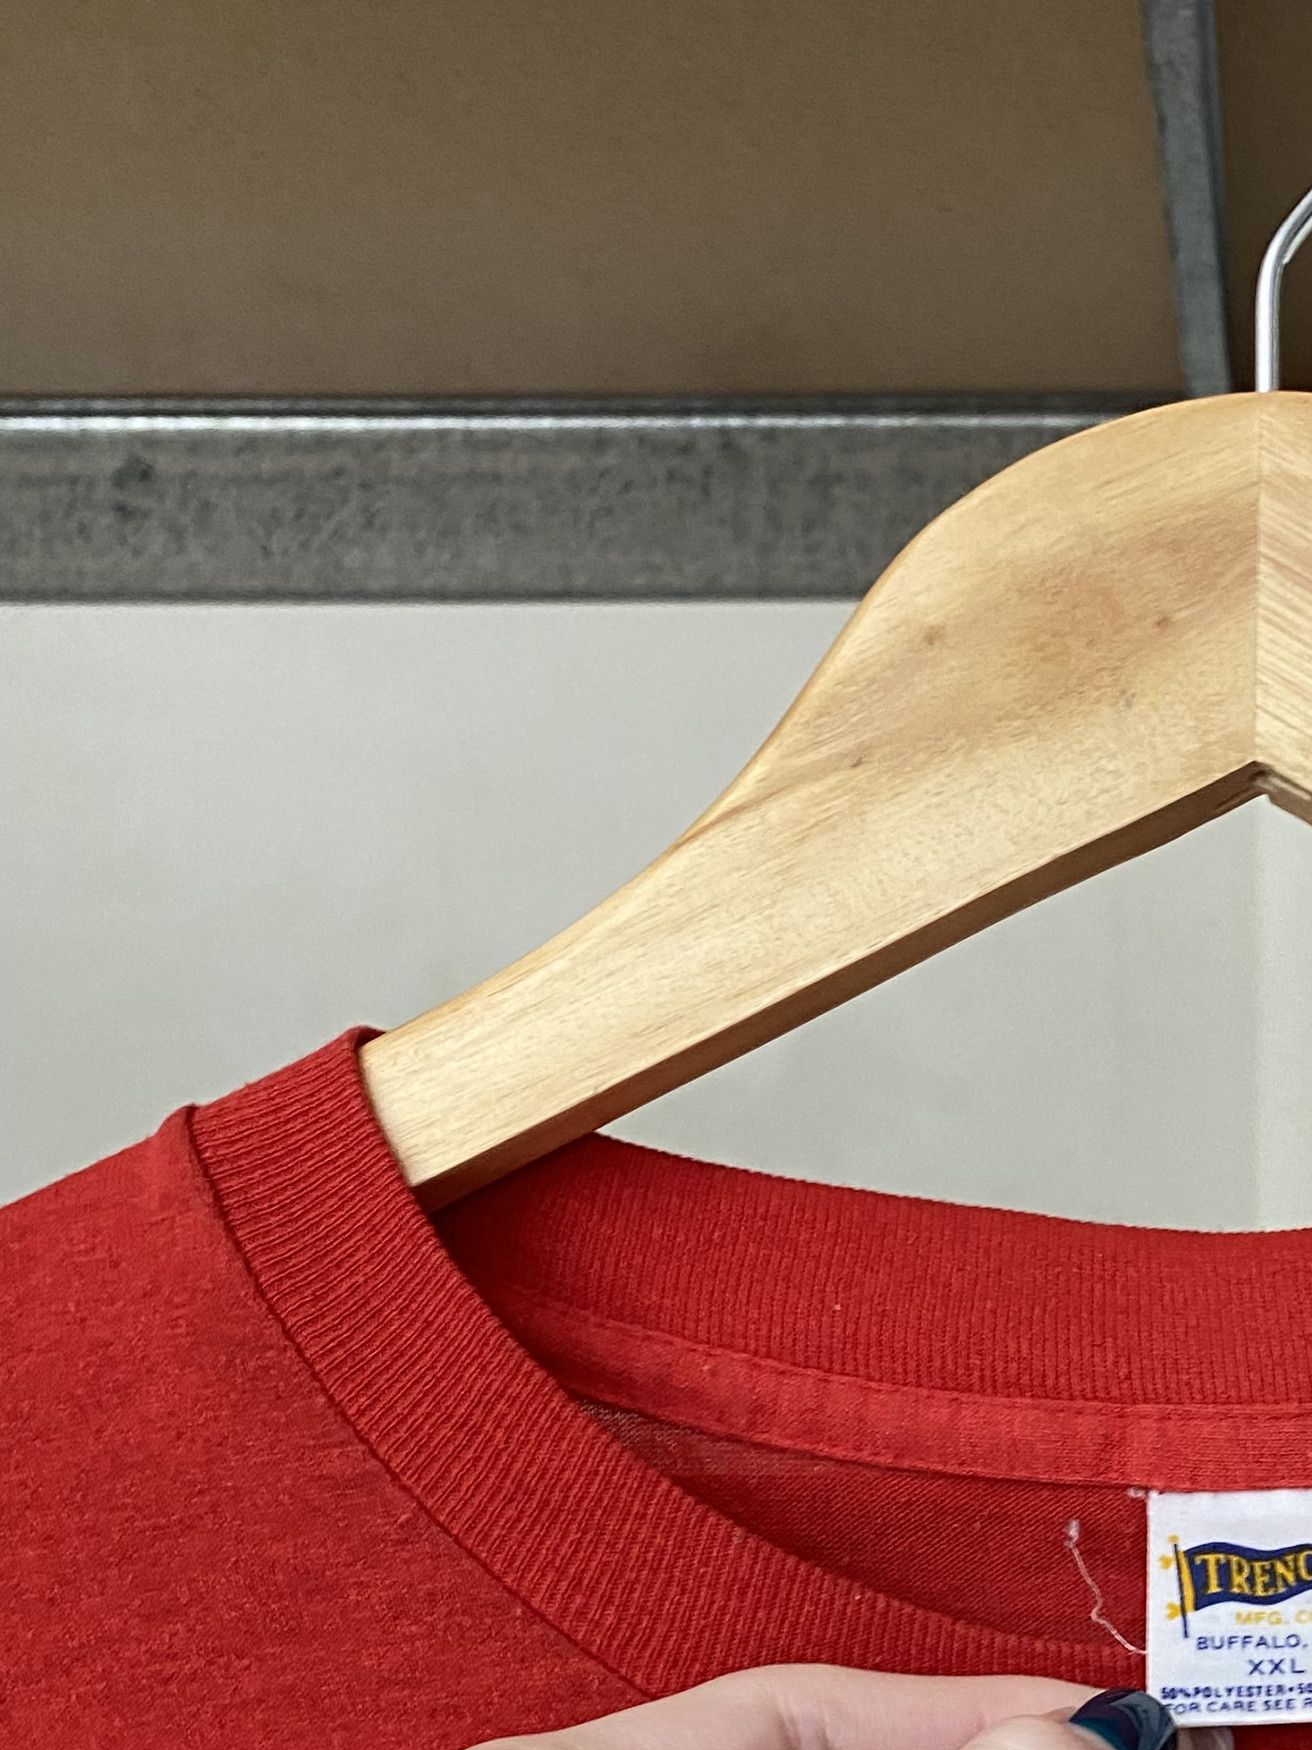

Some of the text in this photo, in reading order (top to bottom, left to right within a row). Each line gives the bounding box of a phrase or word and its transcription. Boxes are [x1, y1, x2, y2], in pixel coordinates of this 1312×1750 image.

[1235, 1610, 1289, 1625] MFG.
[1248, 1657, 1305, 1676] XXL
[1206, 1701, 1257, 1713] CARE
[1264, 1699, 1296, 1711] SEE
